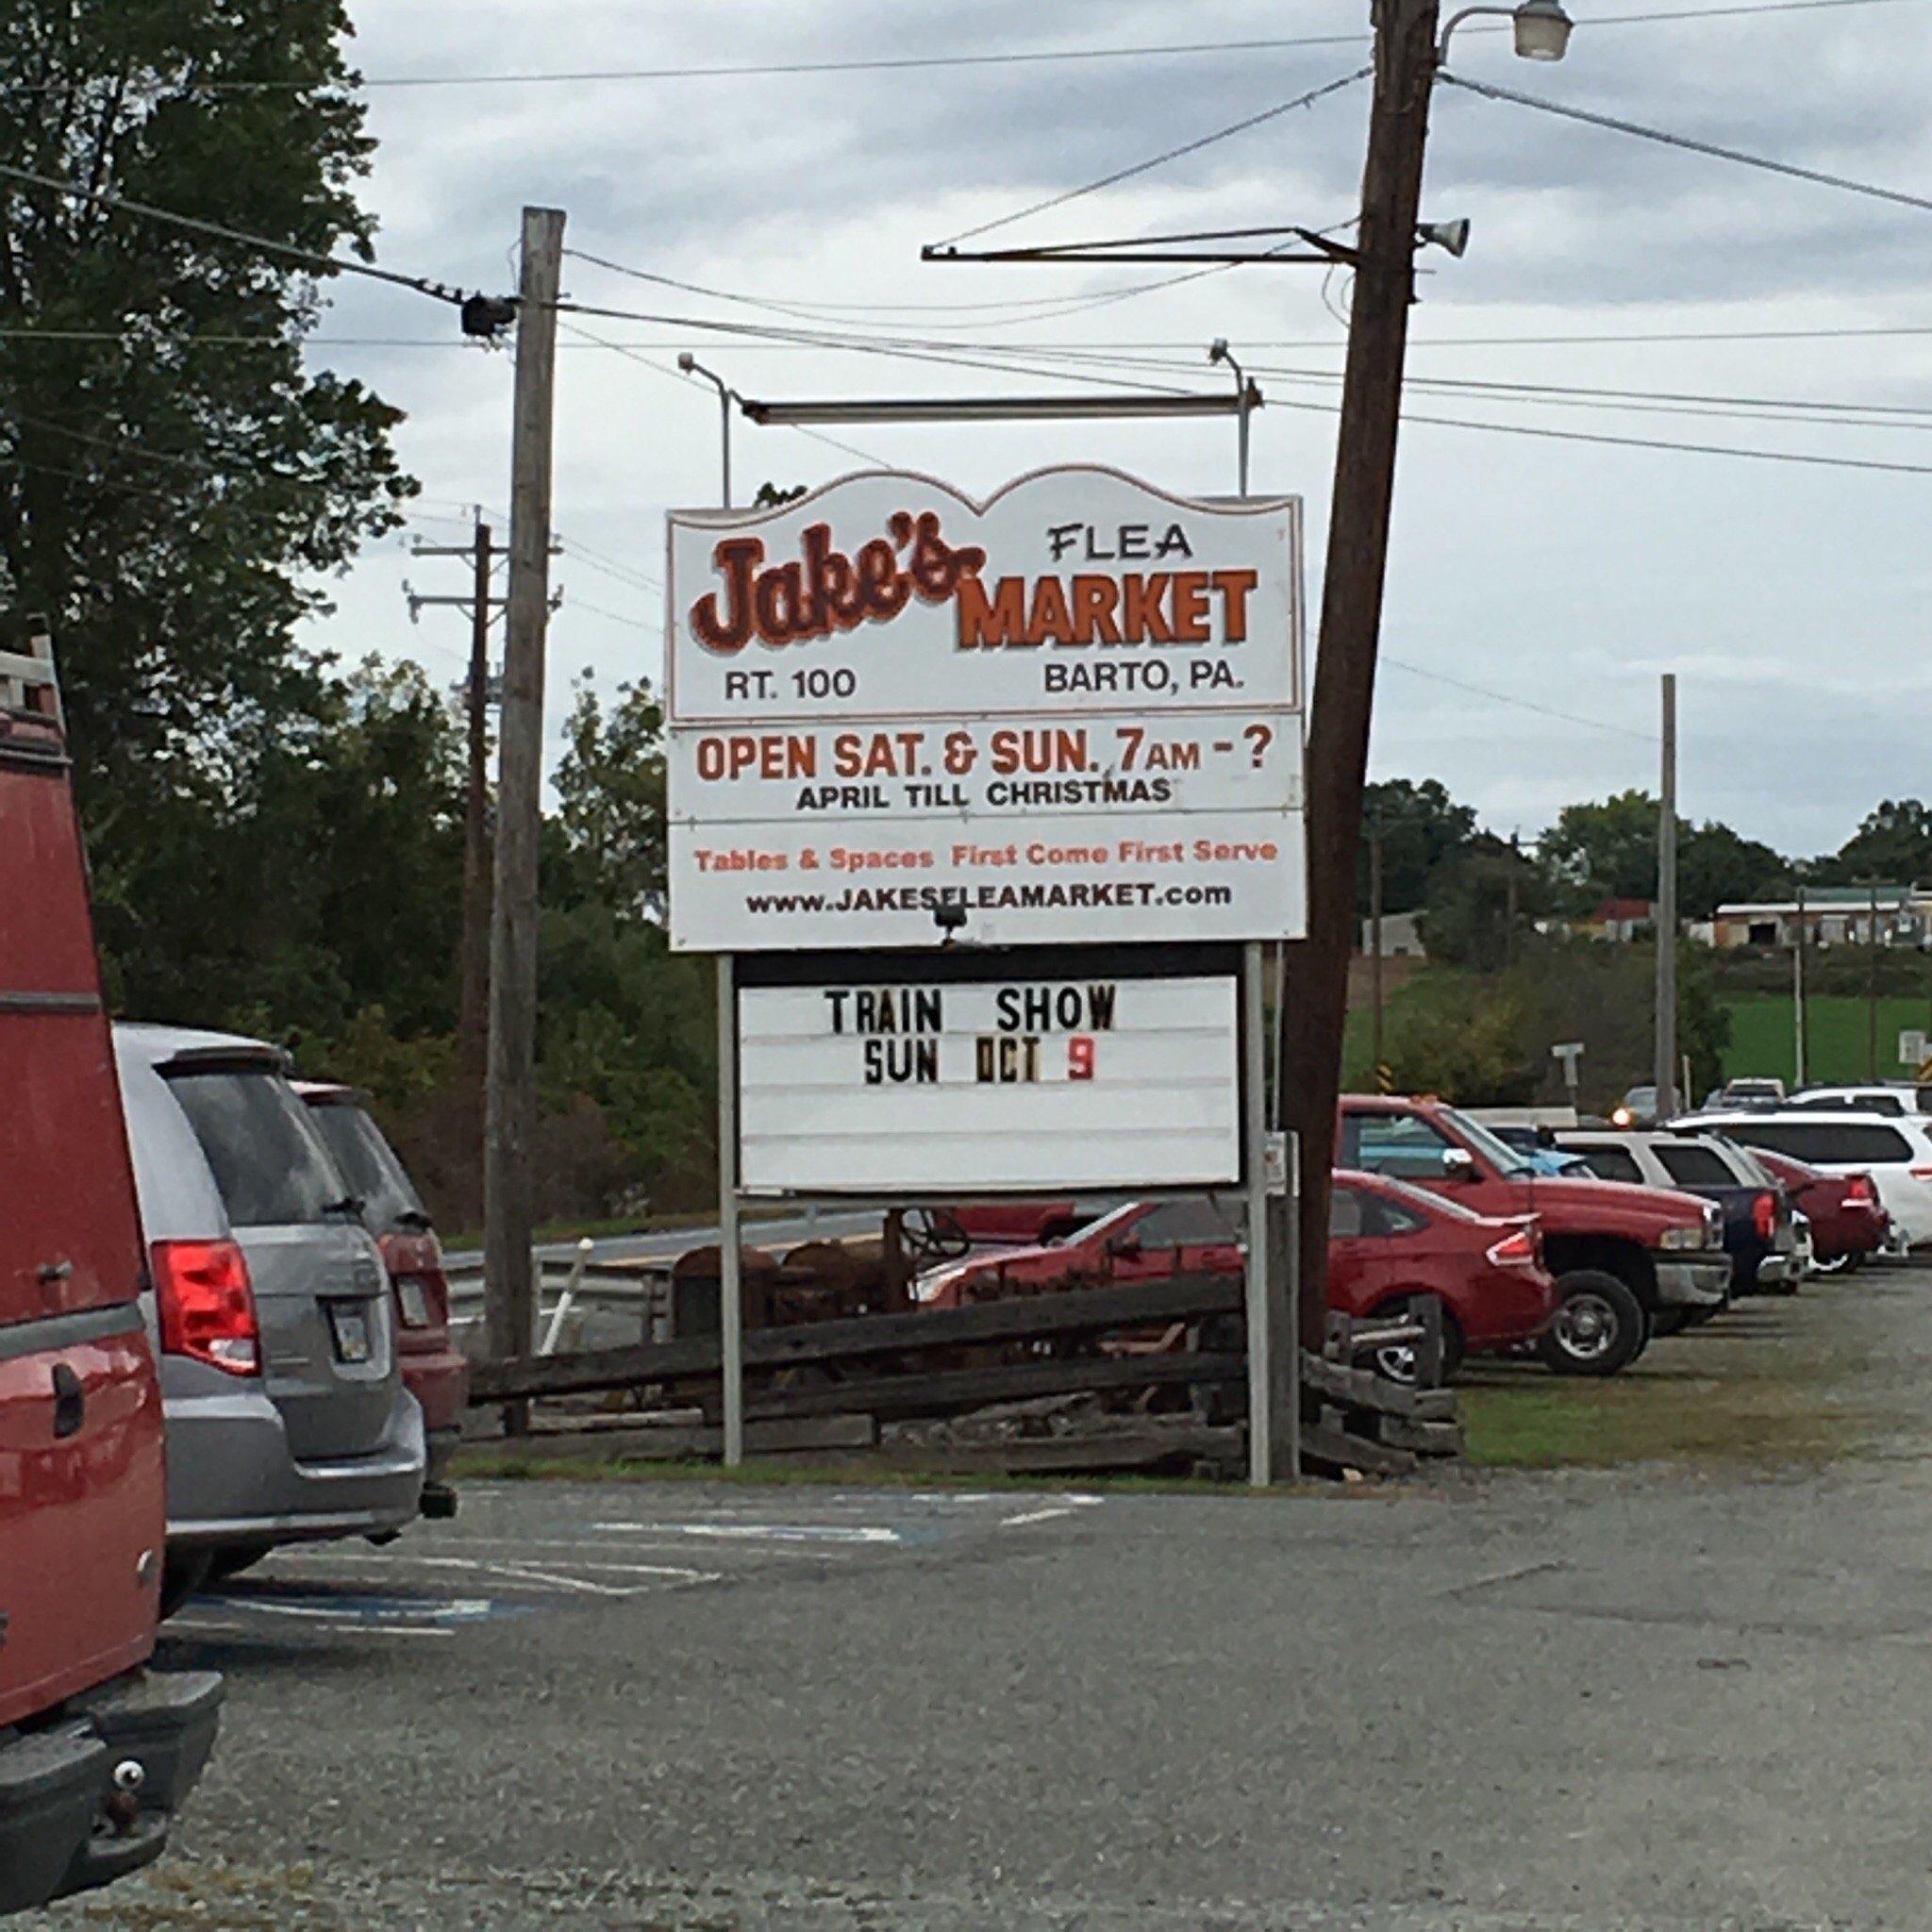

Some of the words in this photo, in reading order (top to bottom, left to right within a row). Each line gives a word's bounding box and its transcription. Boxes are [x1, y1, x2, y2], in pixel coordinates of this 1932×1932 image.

[1047, 524, 1191, 561] FLEA
[691, 510, 986, 653] Jake's
[956, 569, 1257, 649] MARKET
[725, 671, 776, 699] RT.
[792, 668, 856, 697] 100
[1045, 660, 1176, 694] BARTO,
[1190, 661, 1244, 689] PA.
[697, 735, 814, 781] OPEN
[834, 732, 931, 776] SAT.
[944, 731, 977, 774] &
[992, 728, 1099, 774] SUN.
[1243, 724, 1273, 768] ?
[796, 784, 890, 810] APRIL
[905, 783, 969, 807] TILL
[987, 777, 1172, 806] CHRISTMAS
[693, 849, 788, 872] Tables
[801, 849, 820, 870] &
[830, 847, 934, 873] Spaces
[952, 843, 1016, 866] First
[1026, 843, 1108, 866] Come
[1118, 841, 1184, 864] First
[1193, 840, 1278, 862] Serve
[824, 988, 942, 1033] TRAIN
[996, 985, 1115, 1031] SHOW
[865, 1039, 939, 1084] SUN
[976, 1039, 1040, 1083] OCT
[1068, 1038, 1095, 1081] 9
